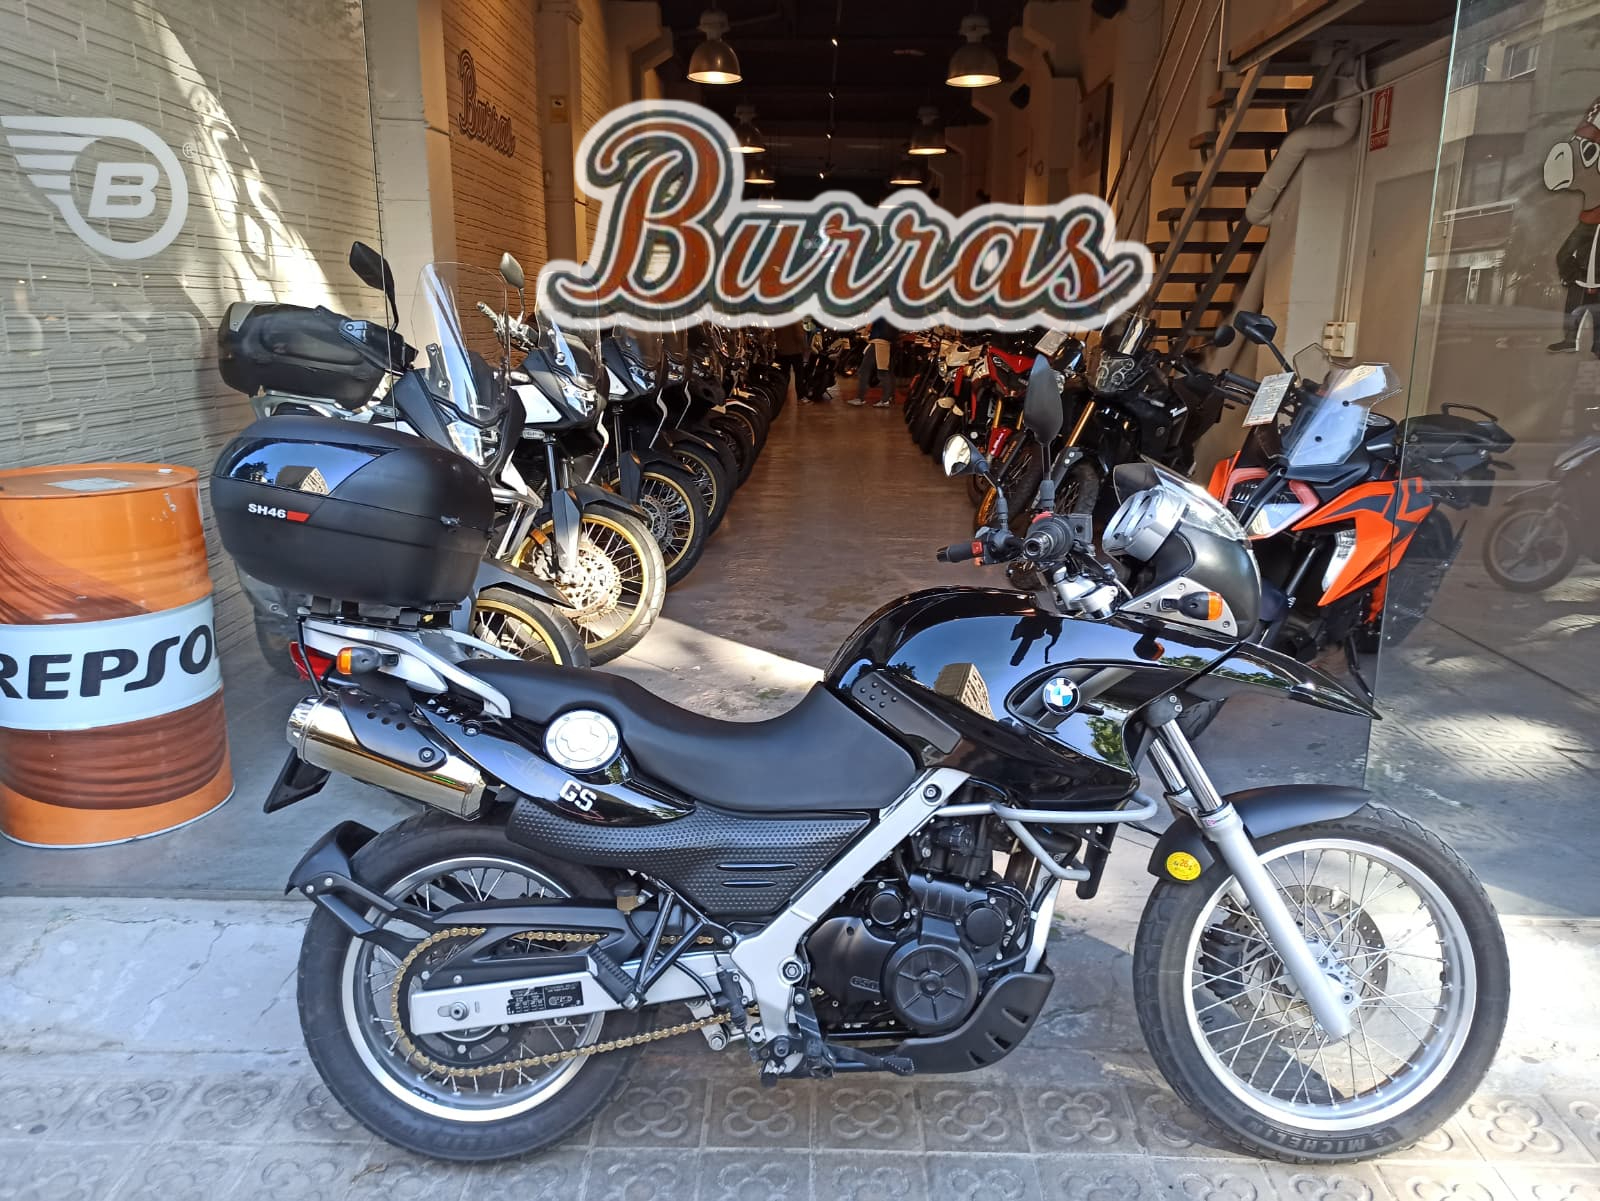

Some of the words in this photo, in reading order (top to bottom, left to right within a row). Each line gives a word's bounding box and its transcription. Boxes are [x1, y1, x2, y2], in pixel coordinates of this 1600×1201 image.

[247, 503, 287, 519] SH46
[0, 617, 219, 699] EPSO
[559, 779, 597, 812] GS
[1247, 1117, 1366, 1153] MICHELIN
